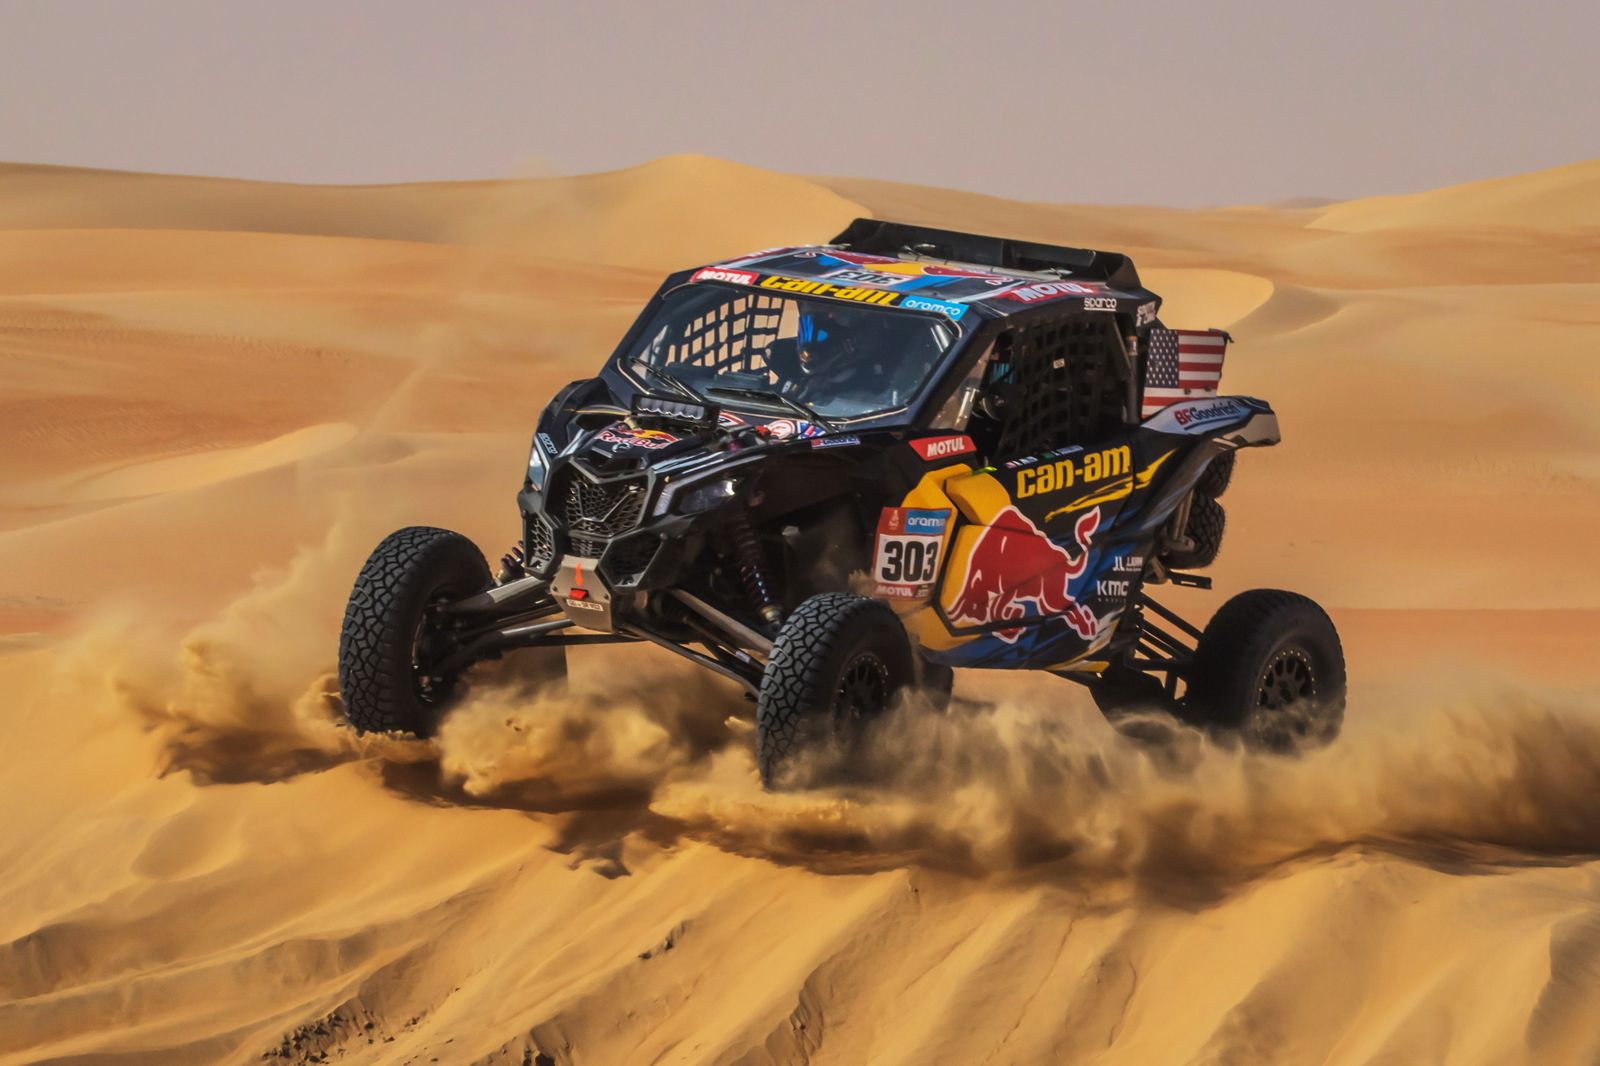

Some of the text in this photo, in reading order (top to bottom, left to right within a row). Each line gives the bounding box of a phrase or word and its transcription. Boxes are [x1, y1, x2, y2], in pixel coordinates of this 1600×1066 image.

[697, 270, 752, 285] MOTUL
[760, 275, 900, 306] can-am
[1011, 281, 1094, 302] MOTUL
[905, 300, 961, 316] aramco
[1083, 297, 1118, 311] sparco
[1174, 399, 1240, 426] BFGoodrich
[927, 437, 965, 457] MOTUL
[1016, 444, 1131, 499] can-am
[881, 541, 939, 582] 303
[876, 586, 913, 598] MOTUL
